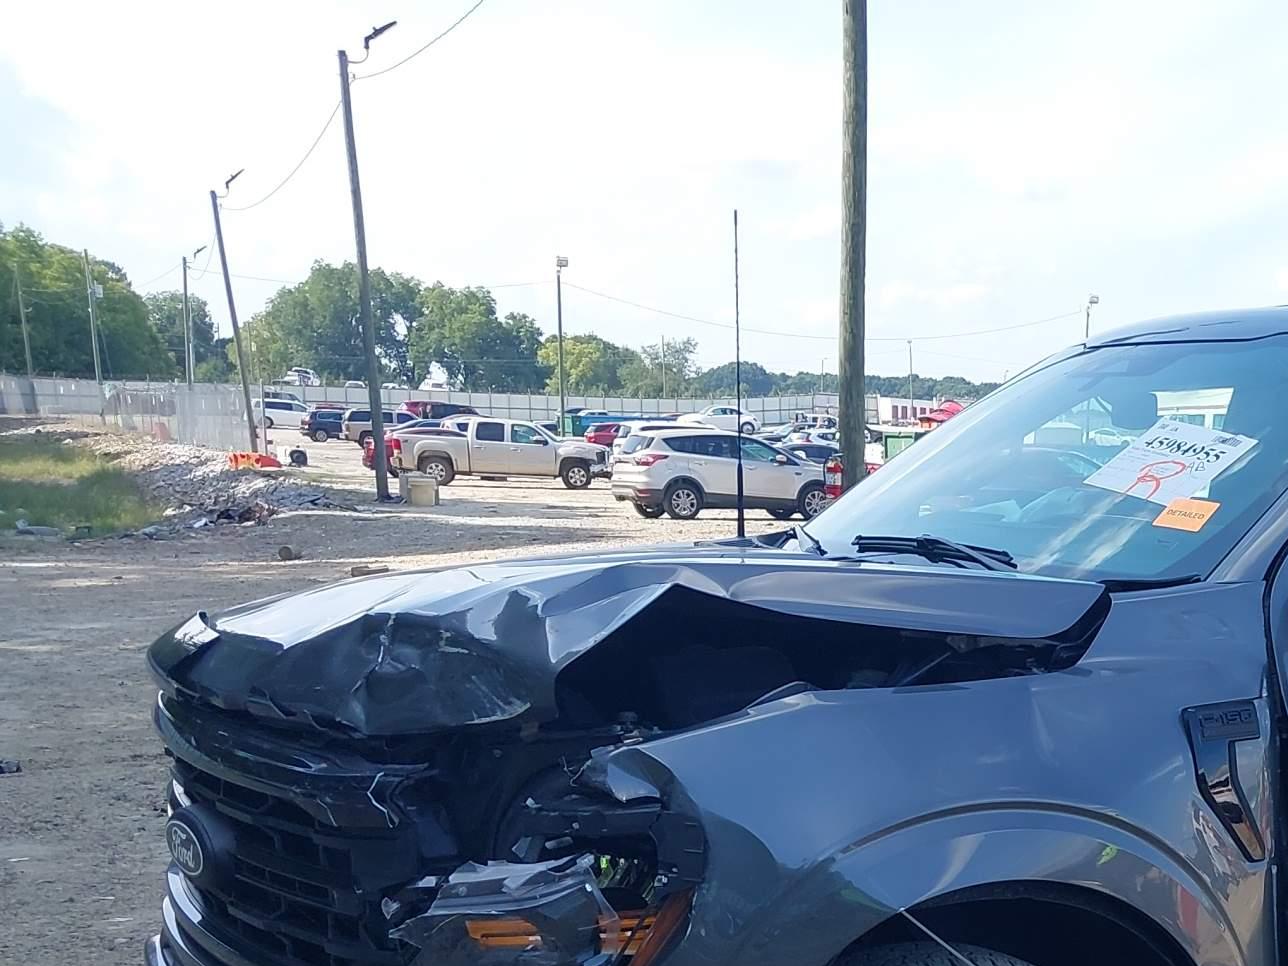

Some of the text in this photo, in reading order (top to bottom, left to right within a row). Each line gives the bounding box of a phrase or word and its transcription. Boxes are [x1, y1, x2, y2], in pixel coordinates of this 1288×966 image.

[1144, 435, 1228, 464] 45984955
[1166, 509, 1205, 520] DETAILED
[171, 826, 196, 869] Ford
